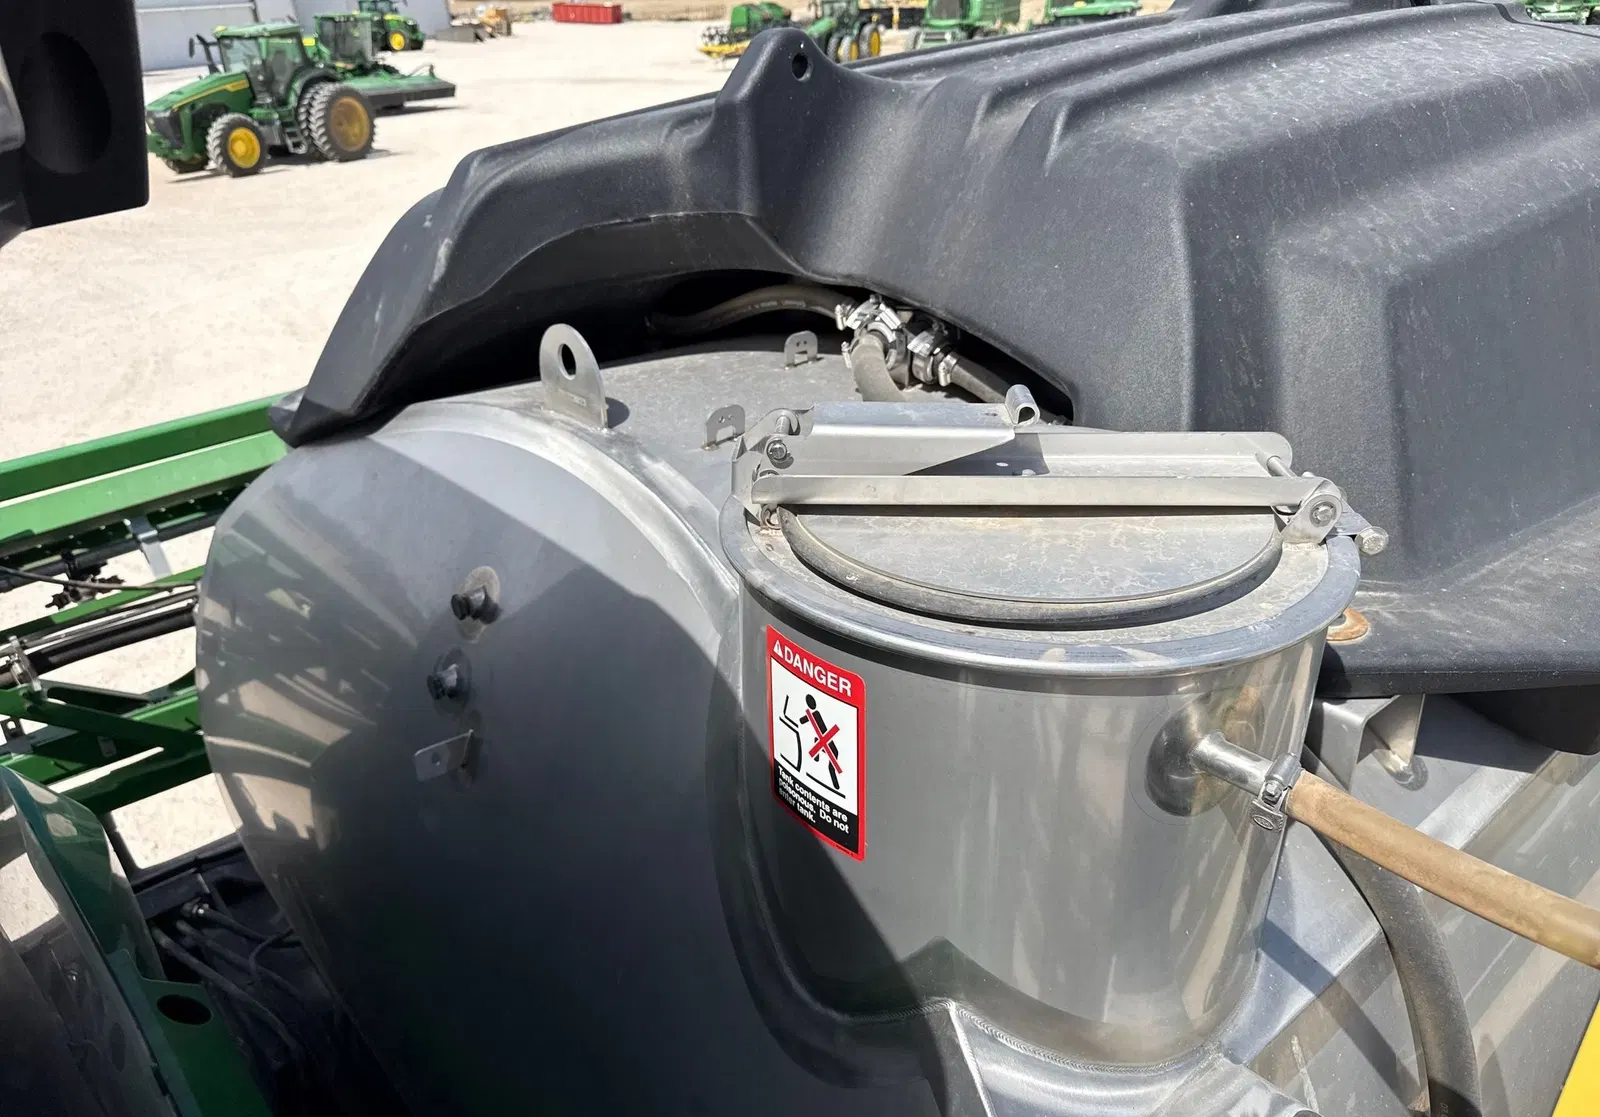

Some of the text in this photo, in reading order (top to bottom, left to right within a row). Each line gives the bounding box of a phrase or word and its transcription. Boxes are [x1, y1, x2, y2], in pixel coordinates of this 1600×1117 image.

[784, 645, 852, 698] DANGER
[778, 765, 848, 823] Tank contents are
[778, 777, 850, 834] poisonous. Do not
[779, 788, 816, 824] enter tank.
